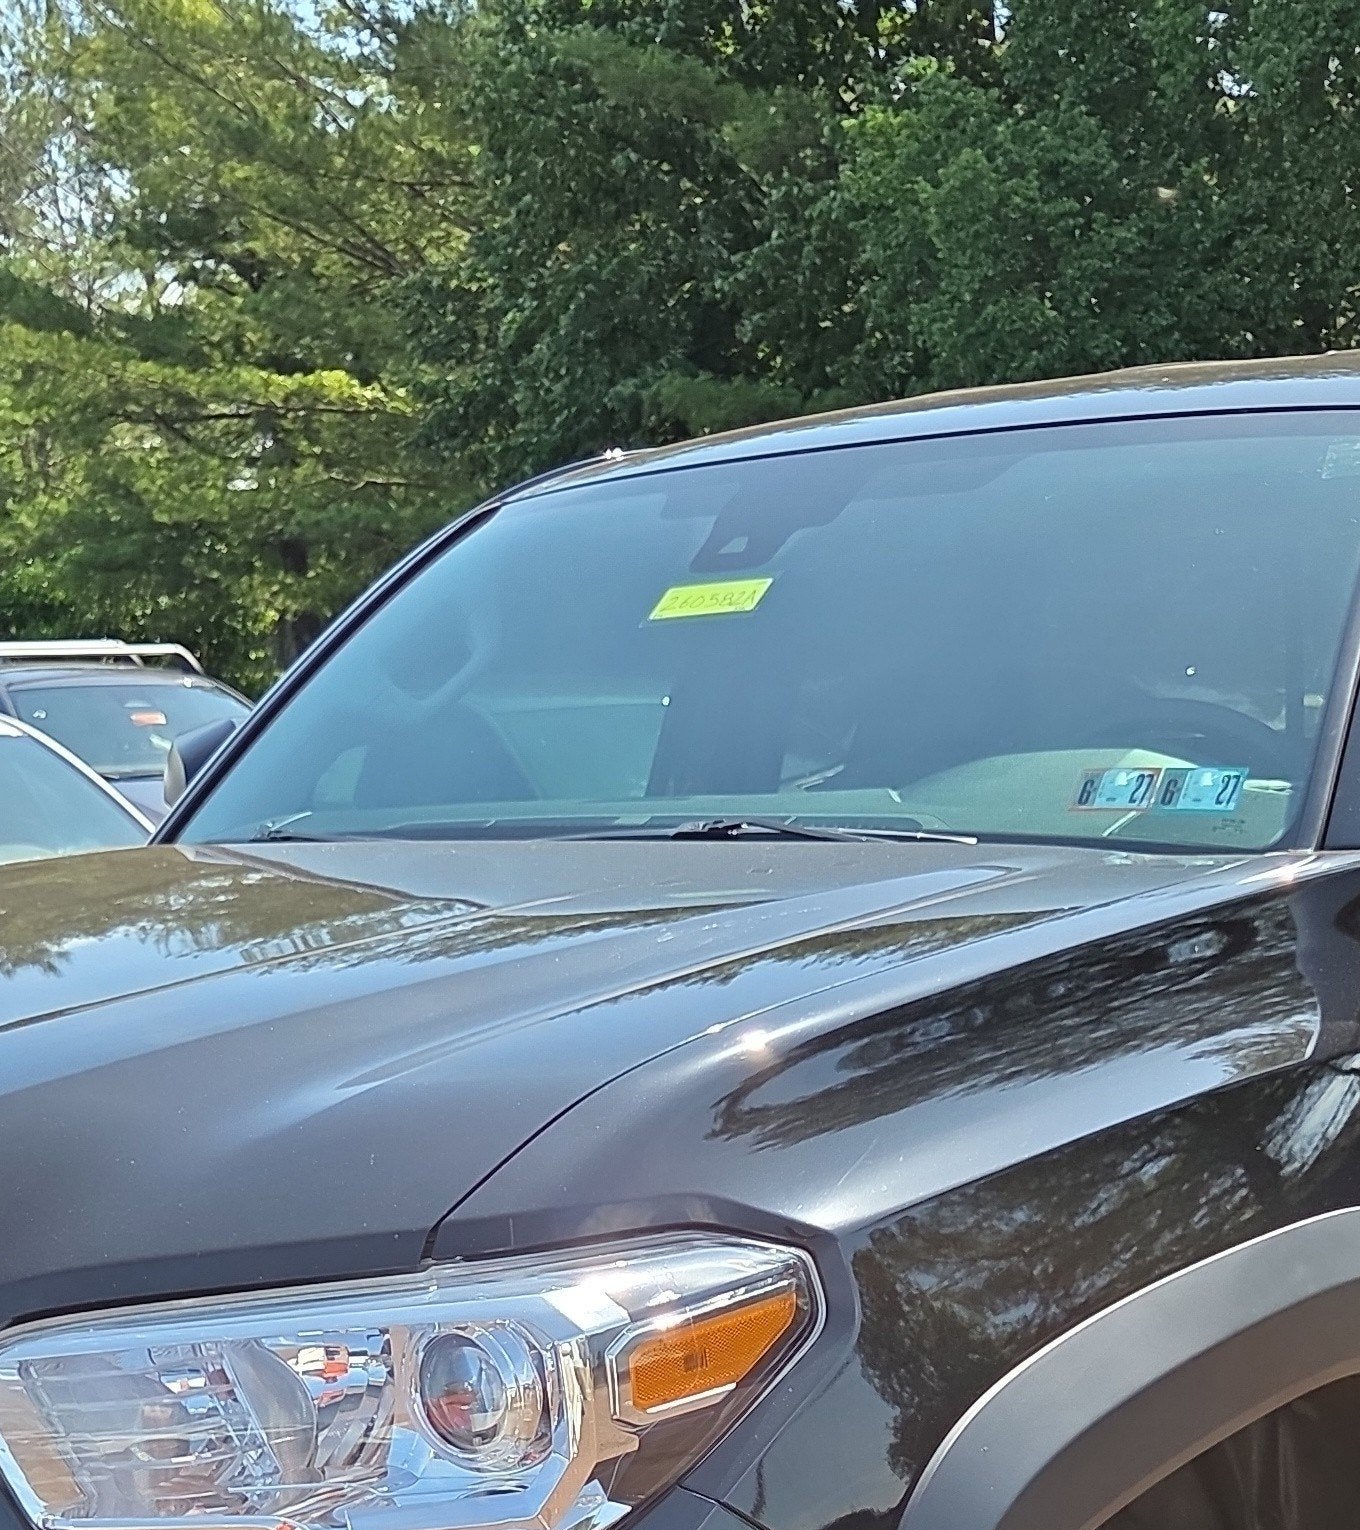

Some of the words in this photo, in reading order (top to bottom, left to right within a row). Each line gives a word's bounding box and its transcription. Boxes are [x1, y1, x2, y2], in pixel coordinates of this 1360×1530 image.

[1078, 779, 1094, 806] 6
[1129, 774, 1154, 804] 27
[1160, 779, 1179, 806] 6
[1215, 775, 1240, 805] 27
